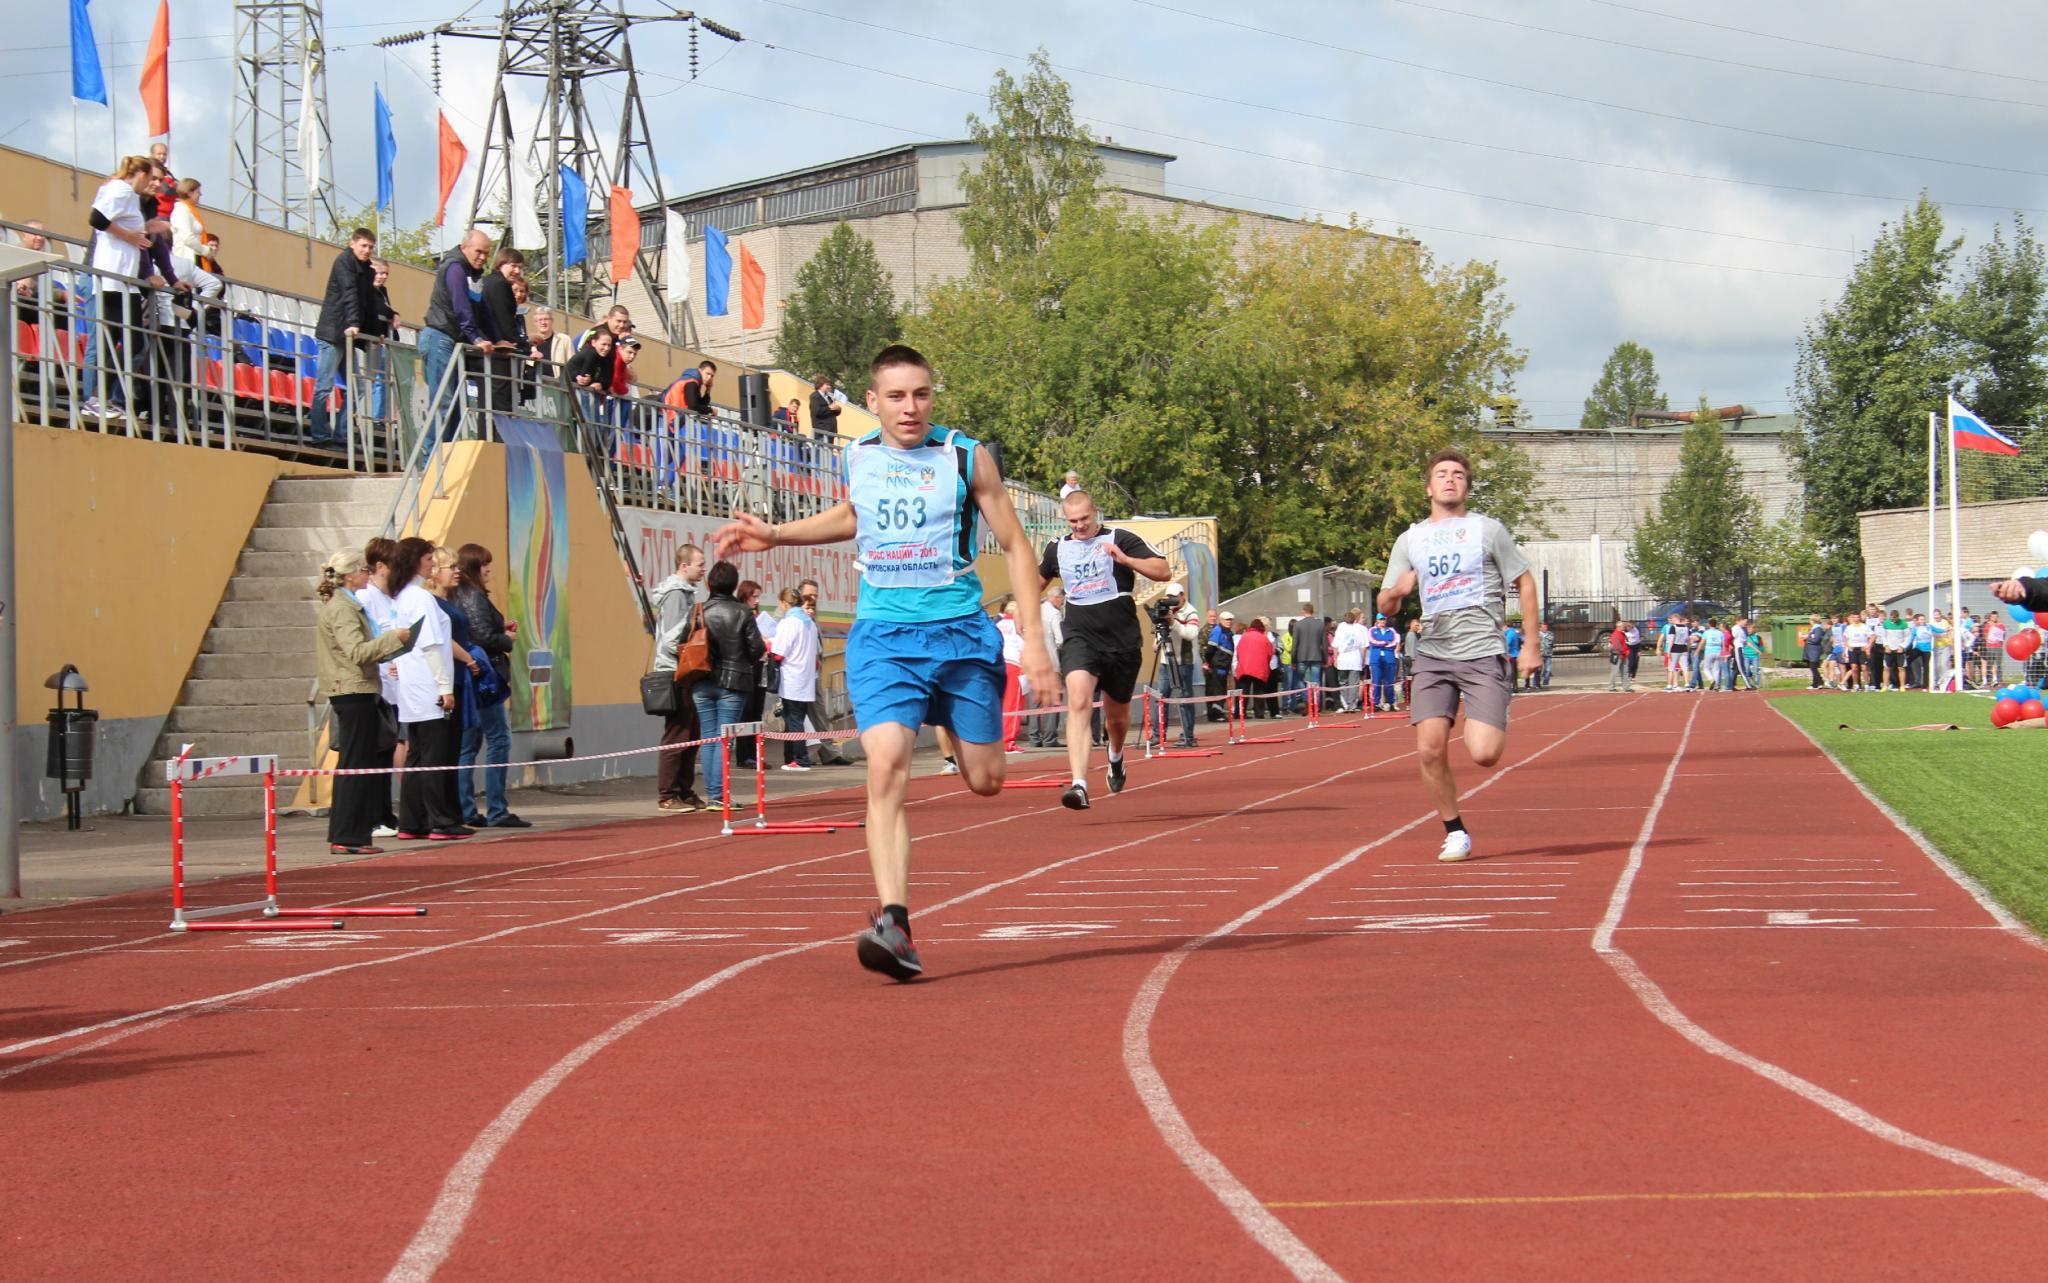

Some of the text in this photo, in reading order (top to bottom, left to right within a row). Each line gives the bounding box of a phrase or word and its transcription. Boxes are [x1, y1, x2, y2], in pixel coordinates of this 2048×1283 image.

[877, 496, 927, 531] 563
[868, 550, 885, 560] РОСС
[887, 549, 913, 560] НАЦИИ
[920, 547, 938, 558] 2013
[867, 562, 938, 572] ИРОВСКАЯ ОБЛАСТЬ
[1074, 561, 1098, 579] 564
[1428, 553, 1461, 577] 562
